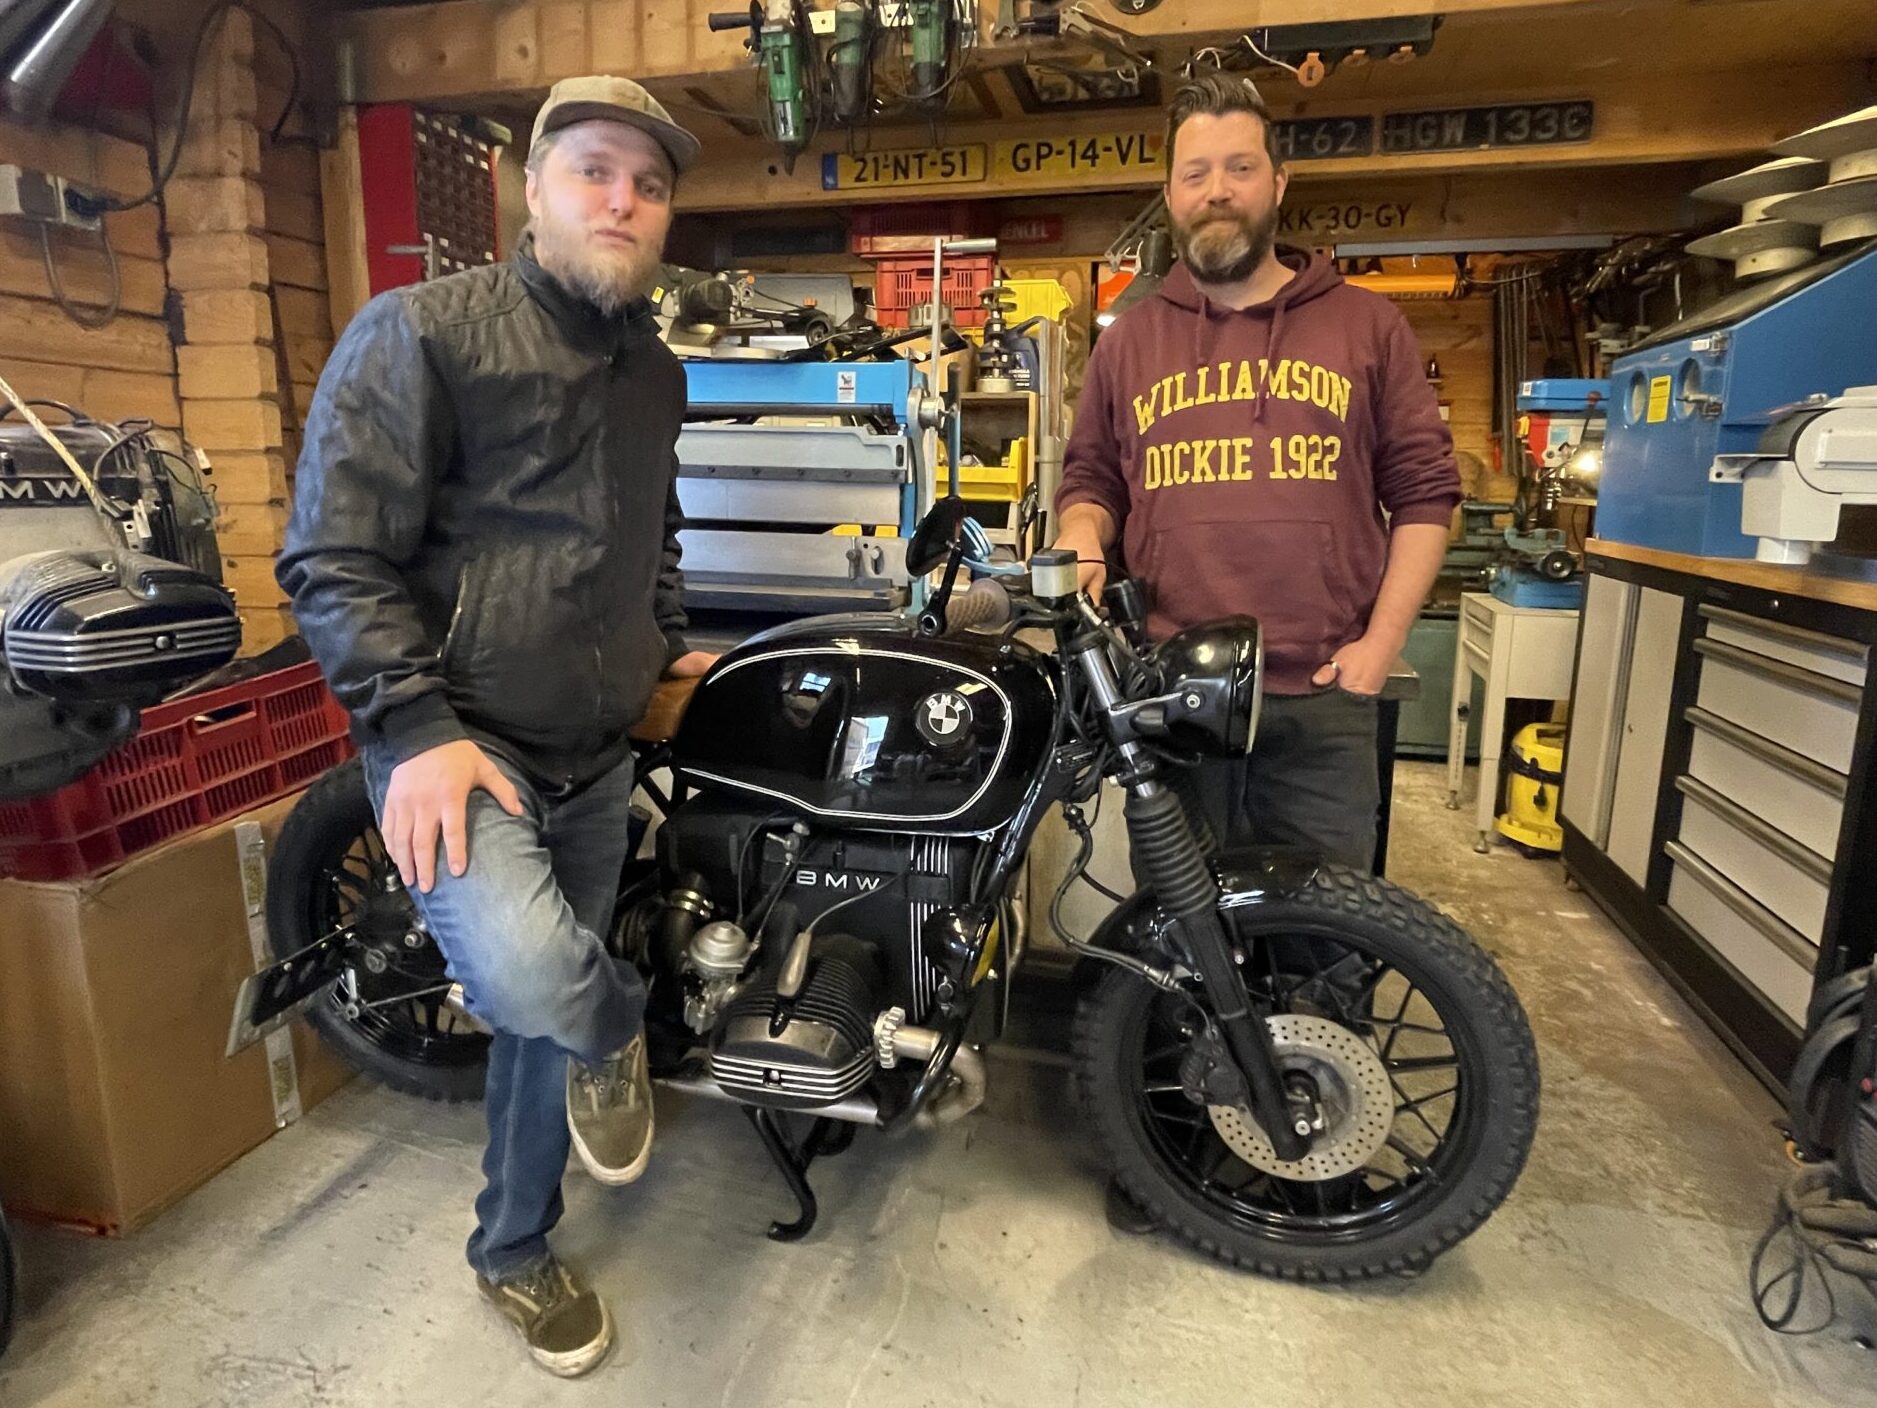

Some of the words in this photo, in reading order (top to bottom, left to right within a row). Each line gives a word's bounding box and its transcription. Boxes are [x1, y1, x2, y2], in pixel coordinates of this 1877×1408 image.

[854, 150, 967, 183] 21-NT-51
[1011, 133, 1156, 173] GP-14-VL
[1278, 202, 1413, 232] KK-30-GY
[1133, 359, 1352, 436] WILLIAMSON
[1144, 437, 1254, 491] DICKIE
[1269, 434, 1342, 481] 1922
[926, 694, 966, 712] BMW
[796, 869, 880, 891] BMW
